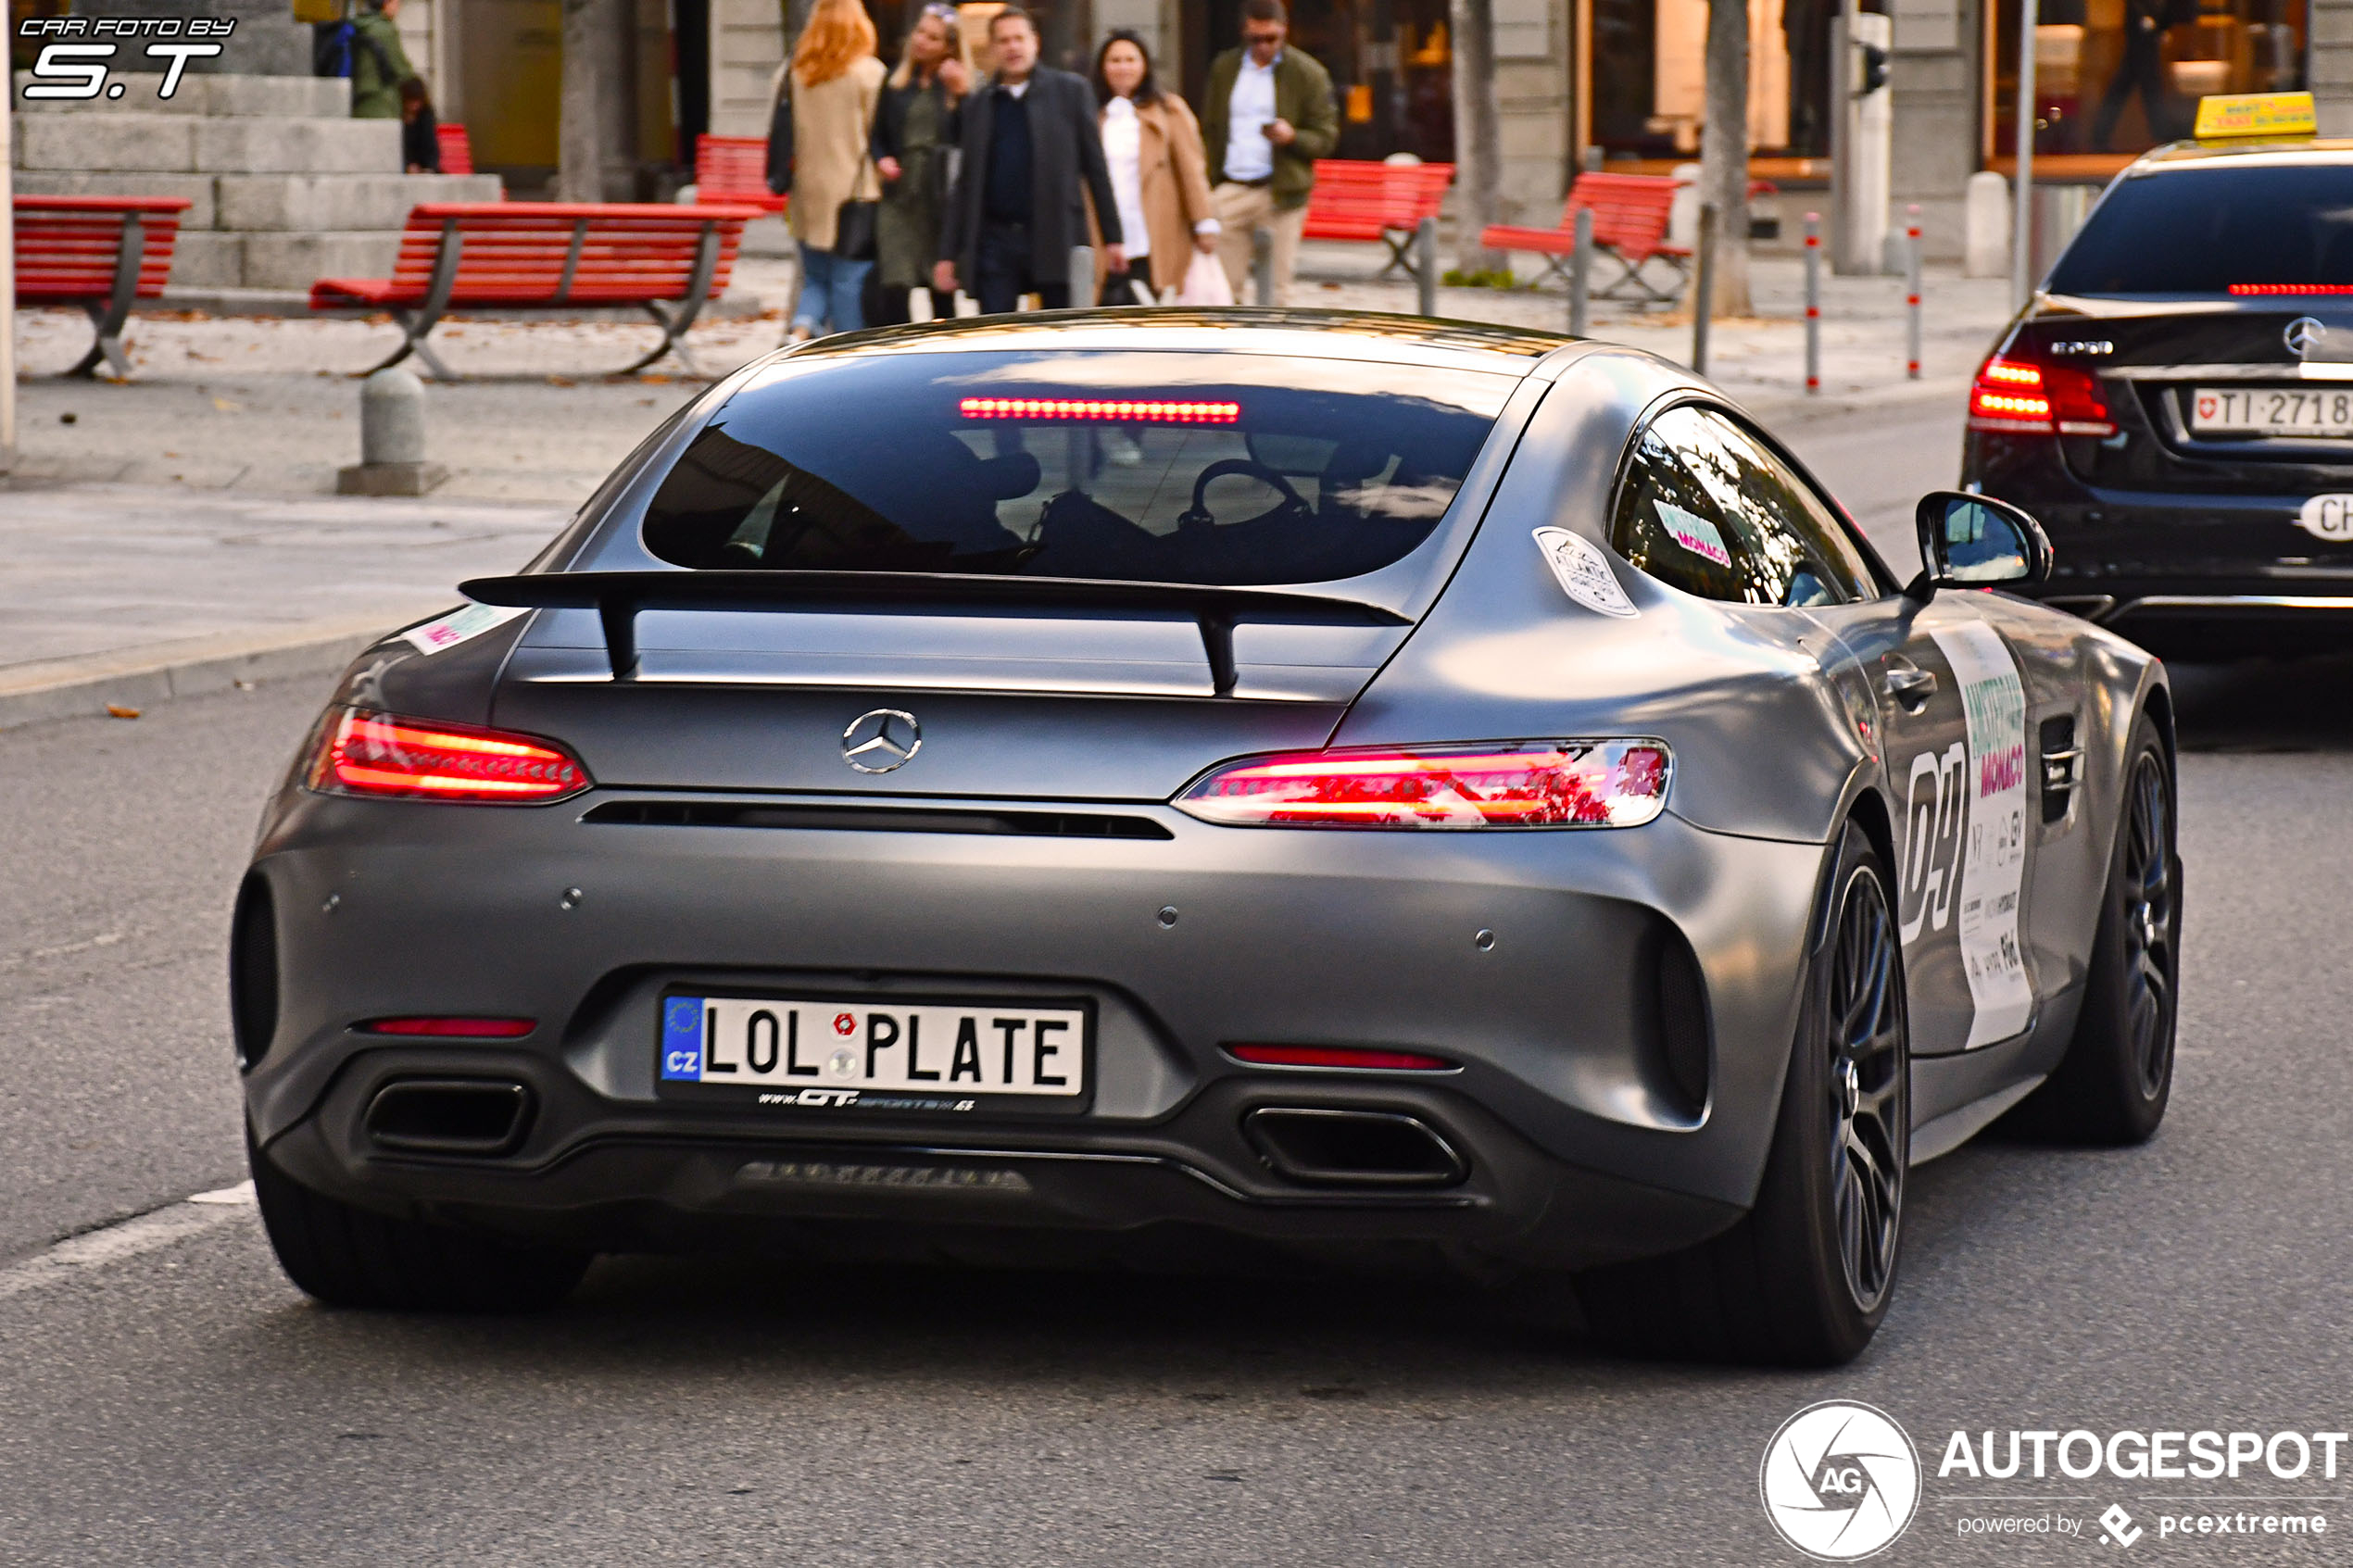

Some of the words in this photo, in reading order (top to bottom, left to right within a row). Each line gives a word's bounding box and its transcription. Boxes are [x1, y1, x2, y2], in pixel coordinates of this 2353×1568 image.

[1677, 530, 1730, 565] MONACO
[1981, 744, 2023, 798] MONACO
[667, 1051, 698, 1073] CZ
[706, 1008, 819, 1076] LOL
[865, 1013, 1069, 1085] PLATE
